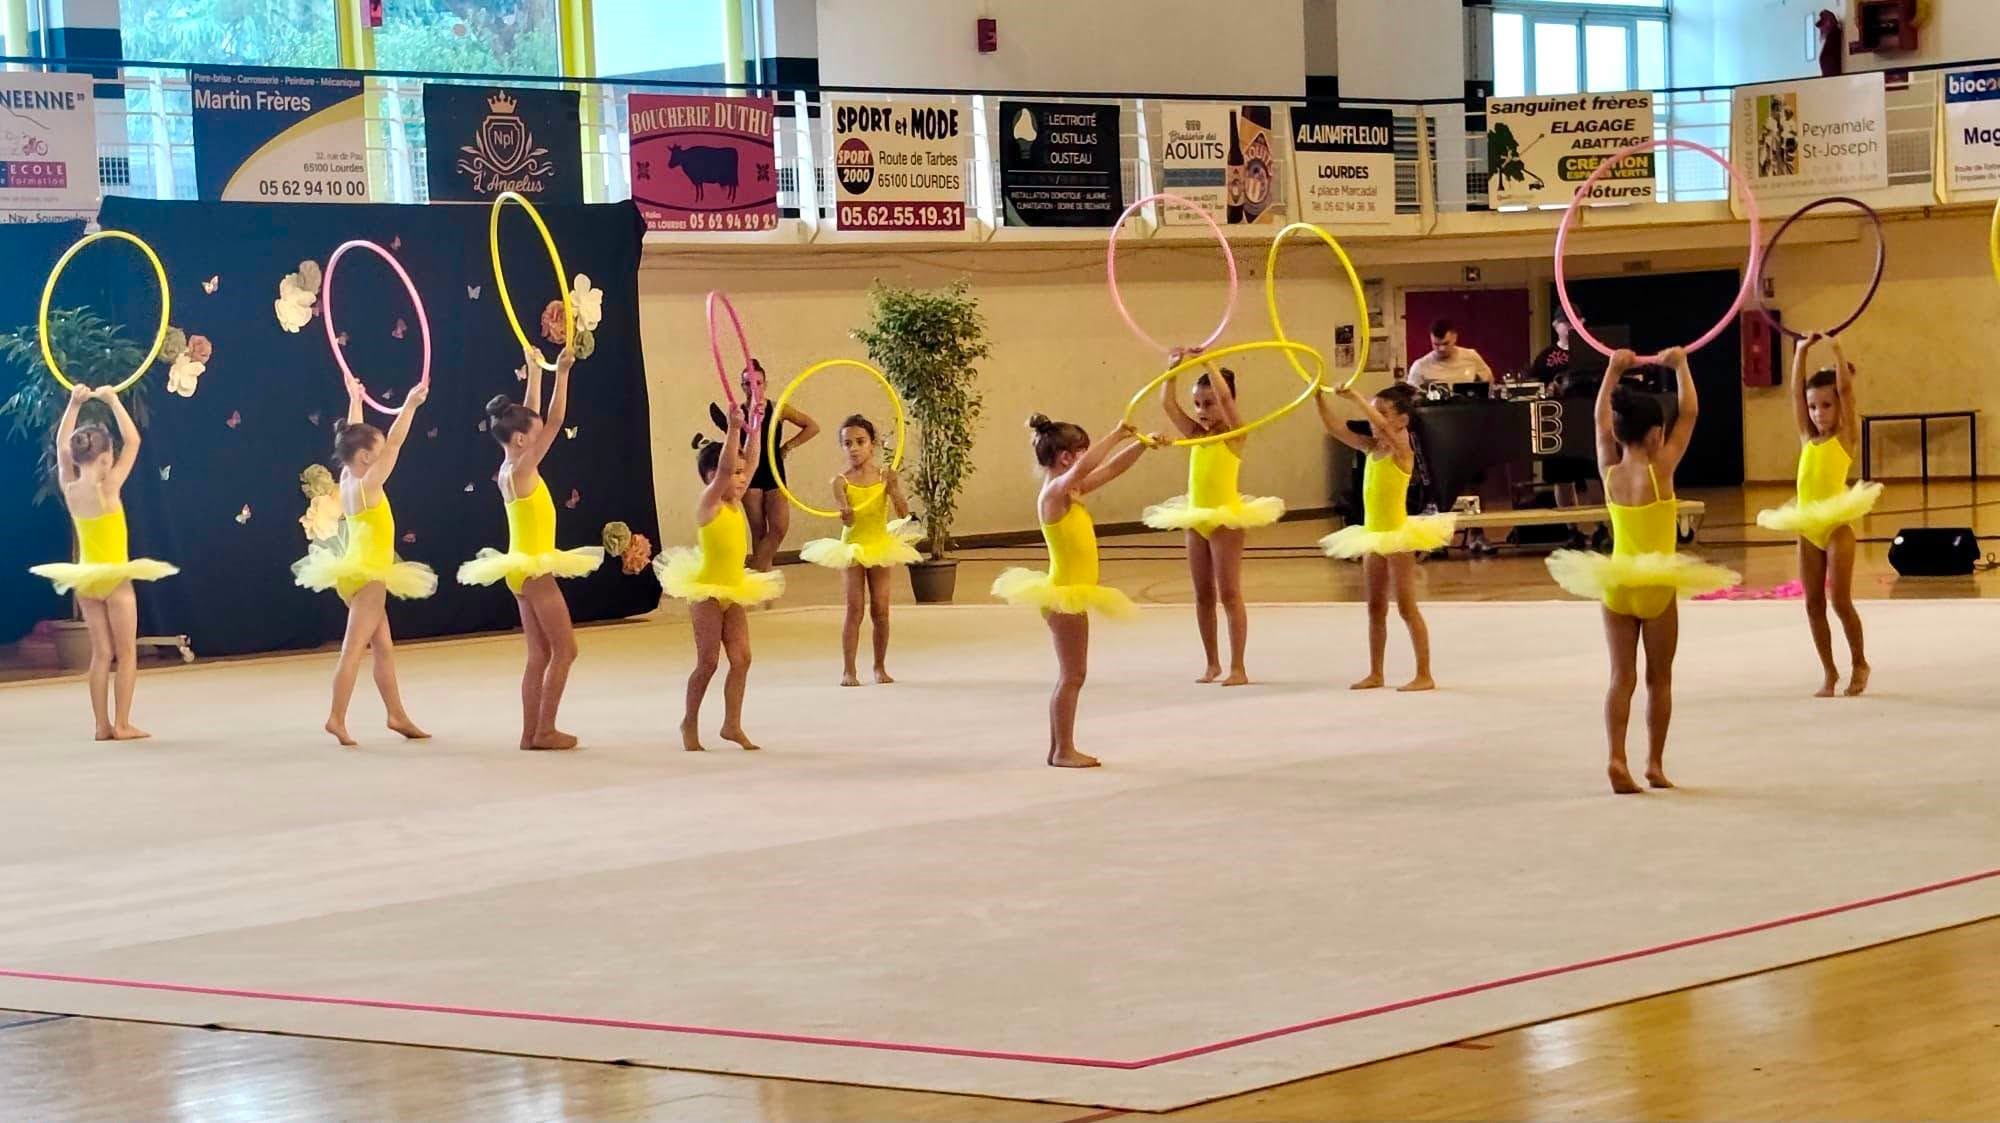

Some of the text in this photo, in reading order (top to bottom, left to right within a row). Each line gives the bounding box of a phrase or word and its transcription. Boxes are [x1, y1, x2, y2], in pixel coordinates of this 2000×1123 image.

[285, 76, 315, 86] Peinture
[321, 77, 361, 88] Mécanique
[194, 89, 311, 112] Martin Frères
[1490, 96, 1649, 117] sanguinet frères
[631, 102, 773, 137] BOUCHERIE DUTHU
[837, 105, 959, 140] SPORT et MODE
[1551, 119, 1636, 134] ELAGAGE
[1802, 118, 1876, 139] Peyramale
[1165, 142, 1224, 159] AOUITS
[1802, 138, 1878, 159] St-Joseph
[838, 150, 870, 164] SPORT
[879, 151, 958, 166] Route de Tarbes
[303, 163, 365, 173] 65100 Lourdes
[843, 168, 871, 183] 2000
[1318, 165, 1369, 179] LOURDES
[260, 180, 365, 196] 05 62 94 10 00
[878, 174, 960, 189] 65100 LOURDES
[690, 213, 705, 229] 05
[709, 213, 723, 229] 62
[726, 213, 741, 230] 94
[744, 214, 759, 230] 29
[841, 206, 961, 226] 05.62.55.19.31
